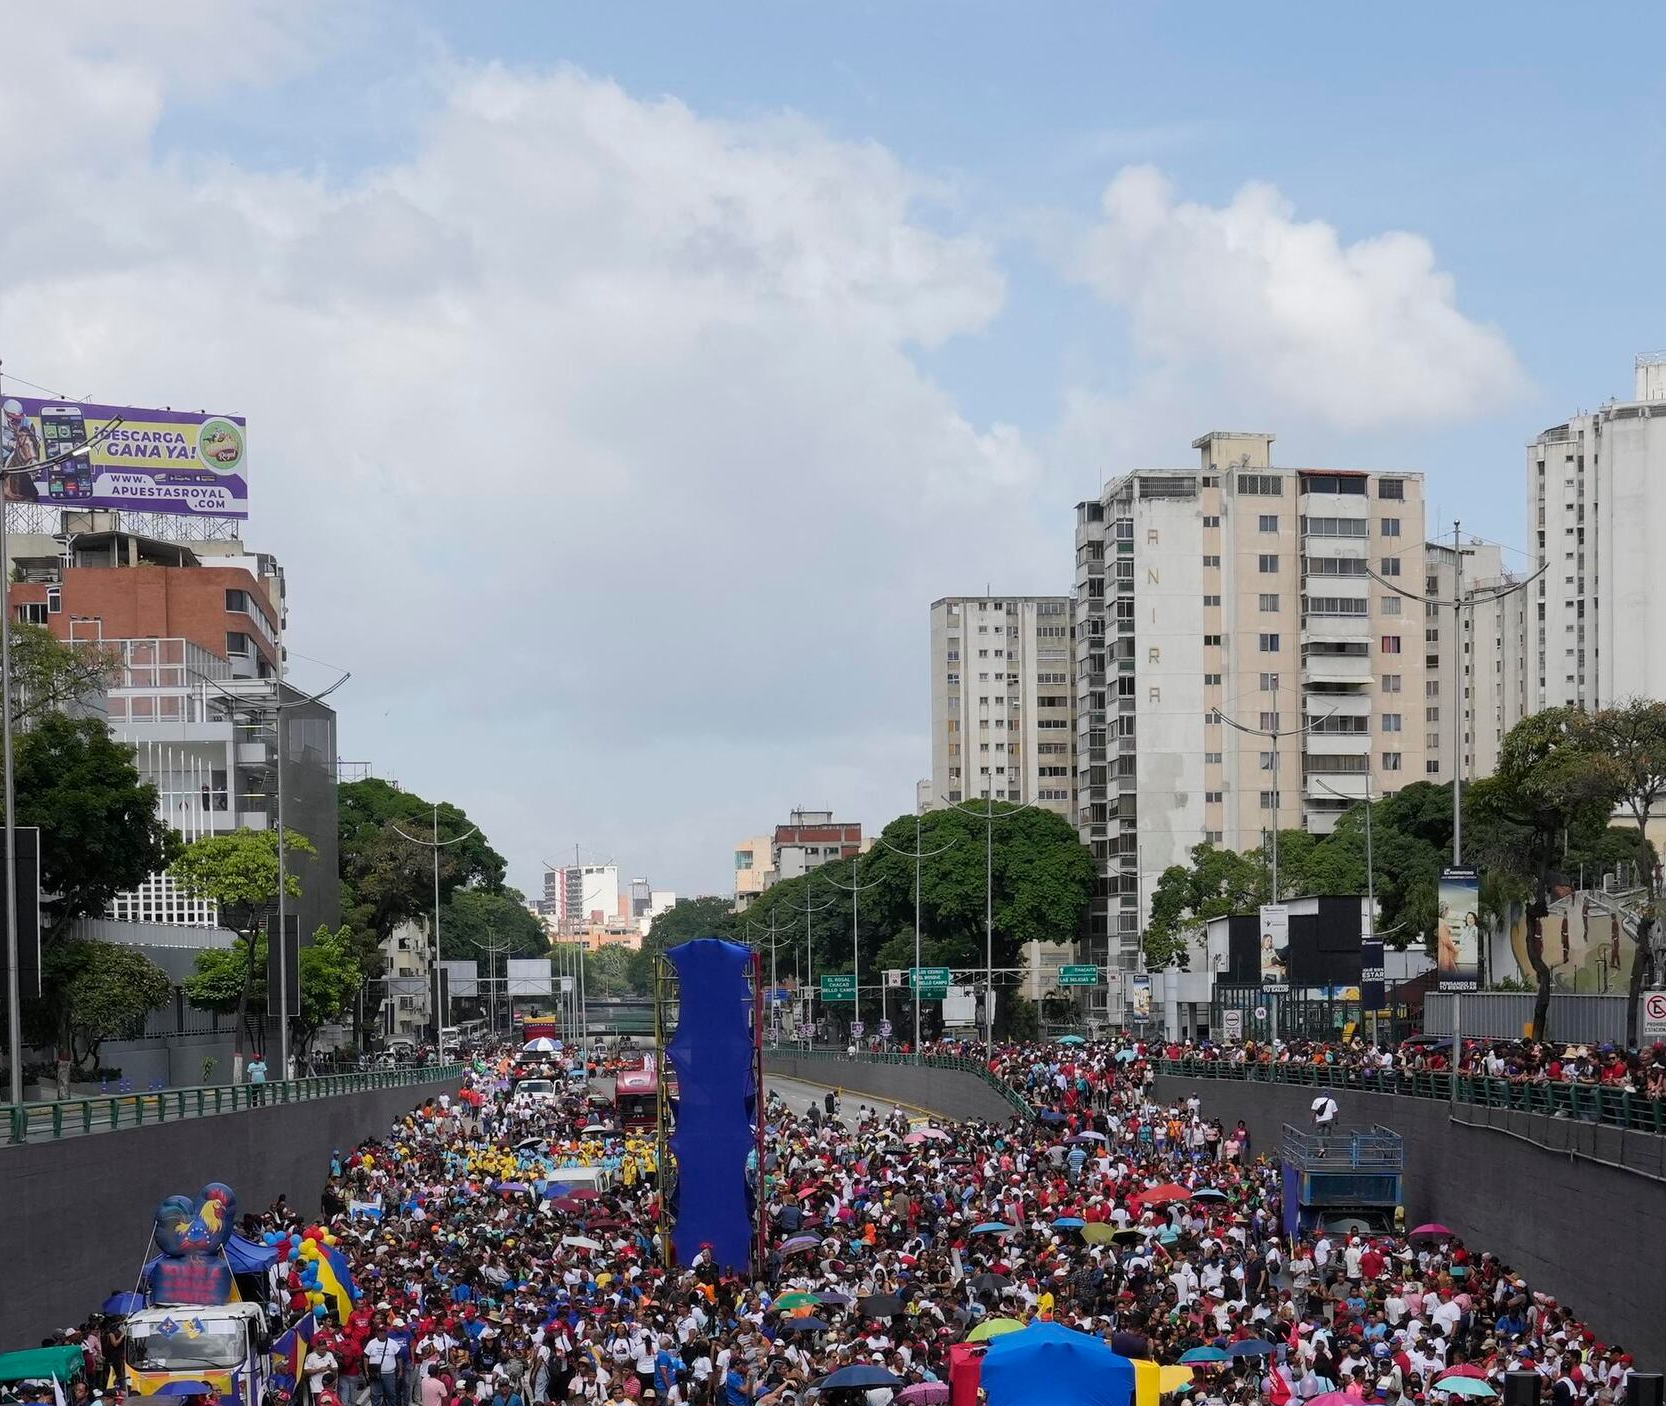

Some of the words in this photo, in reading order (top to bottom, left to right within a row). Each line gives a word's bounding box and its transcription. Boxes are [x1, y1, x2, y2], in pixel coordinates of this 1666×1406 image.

[107, 443, 163, 459] GANA
[164, 445, 196, 460] YA!
[111, 475, 147, 484] WWW.
[111, 485, 225, 499] APUESTASROYAL
[194, 499, 225, 509] .COM
